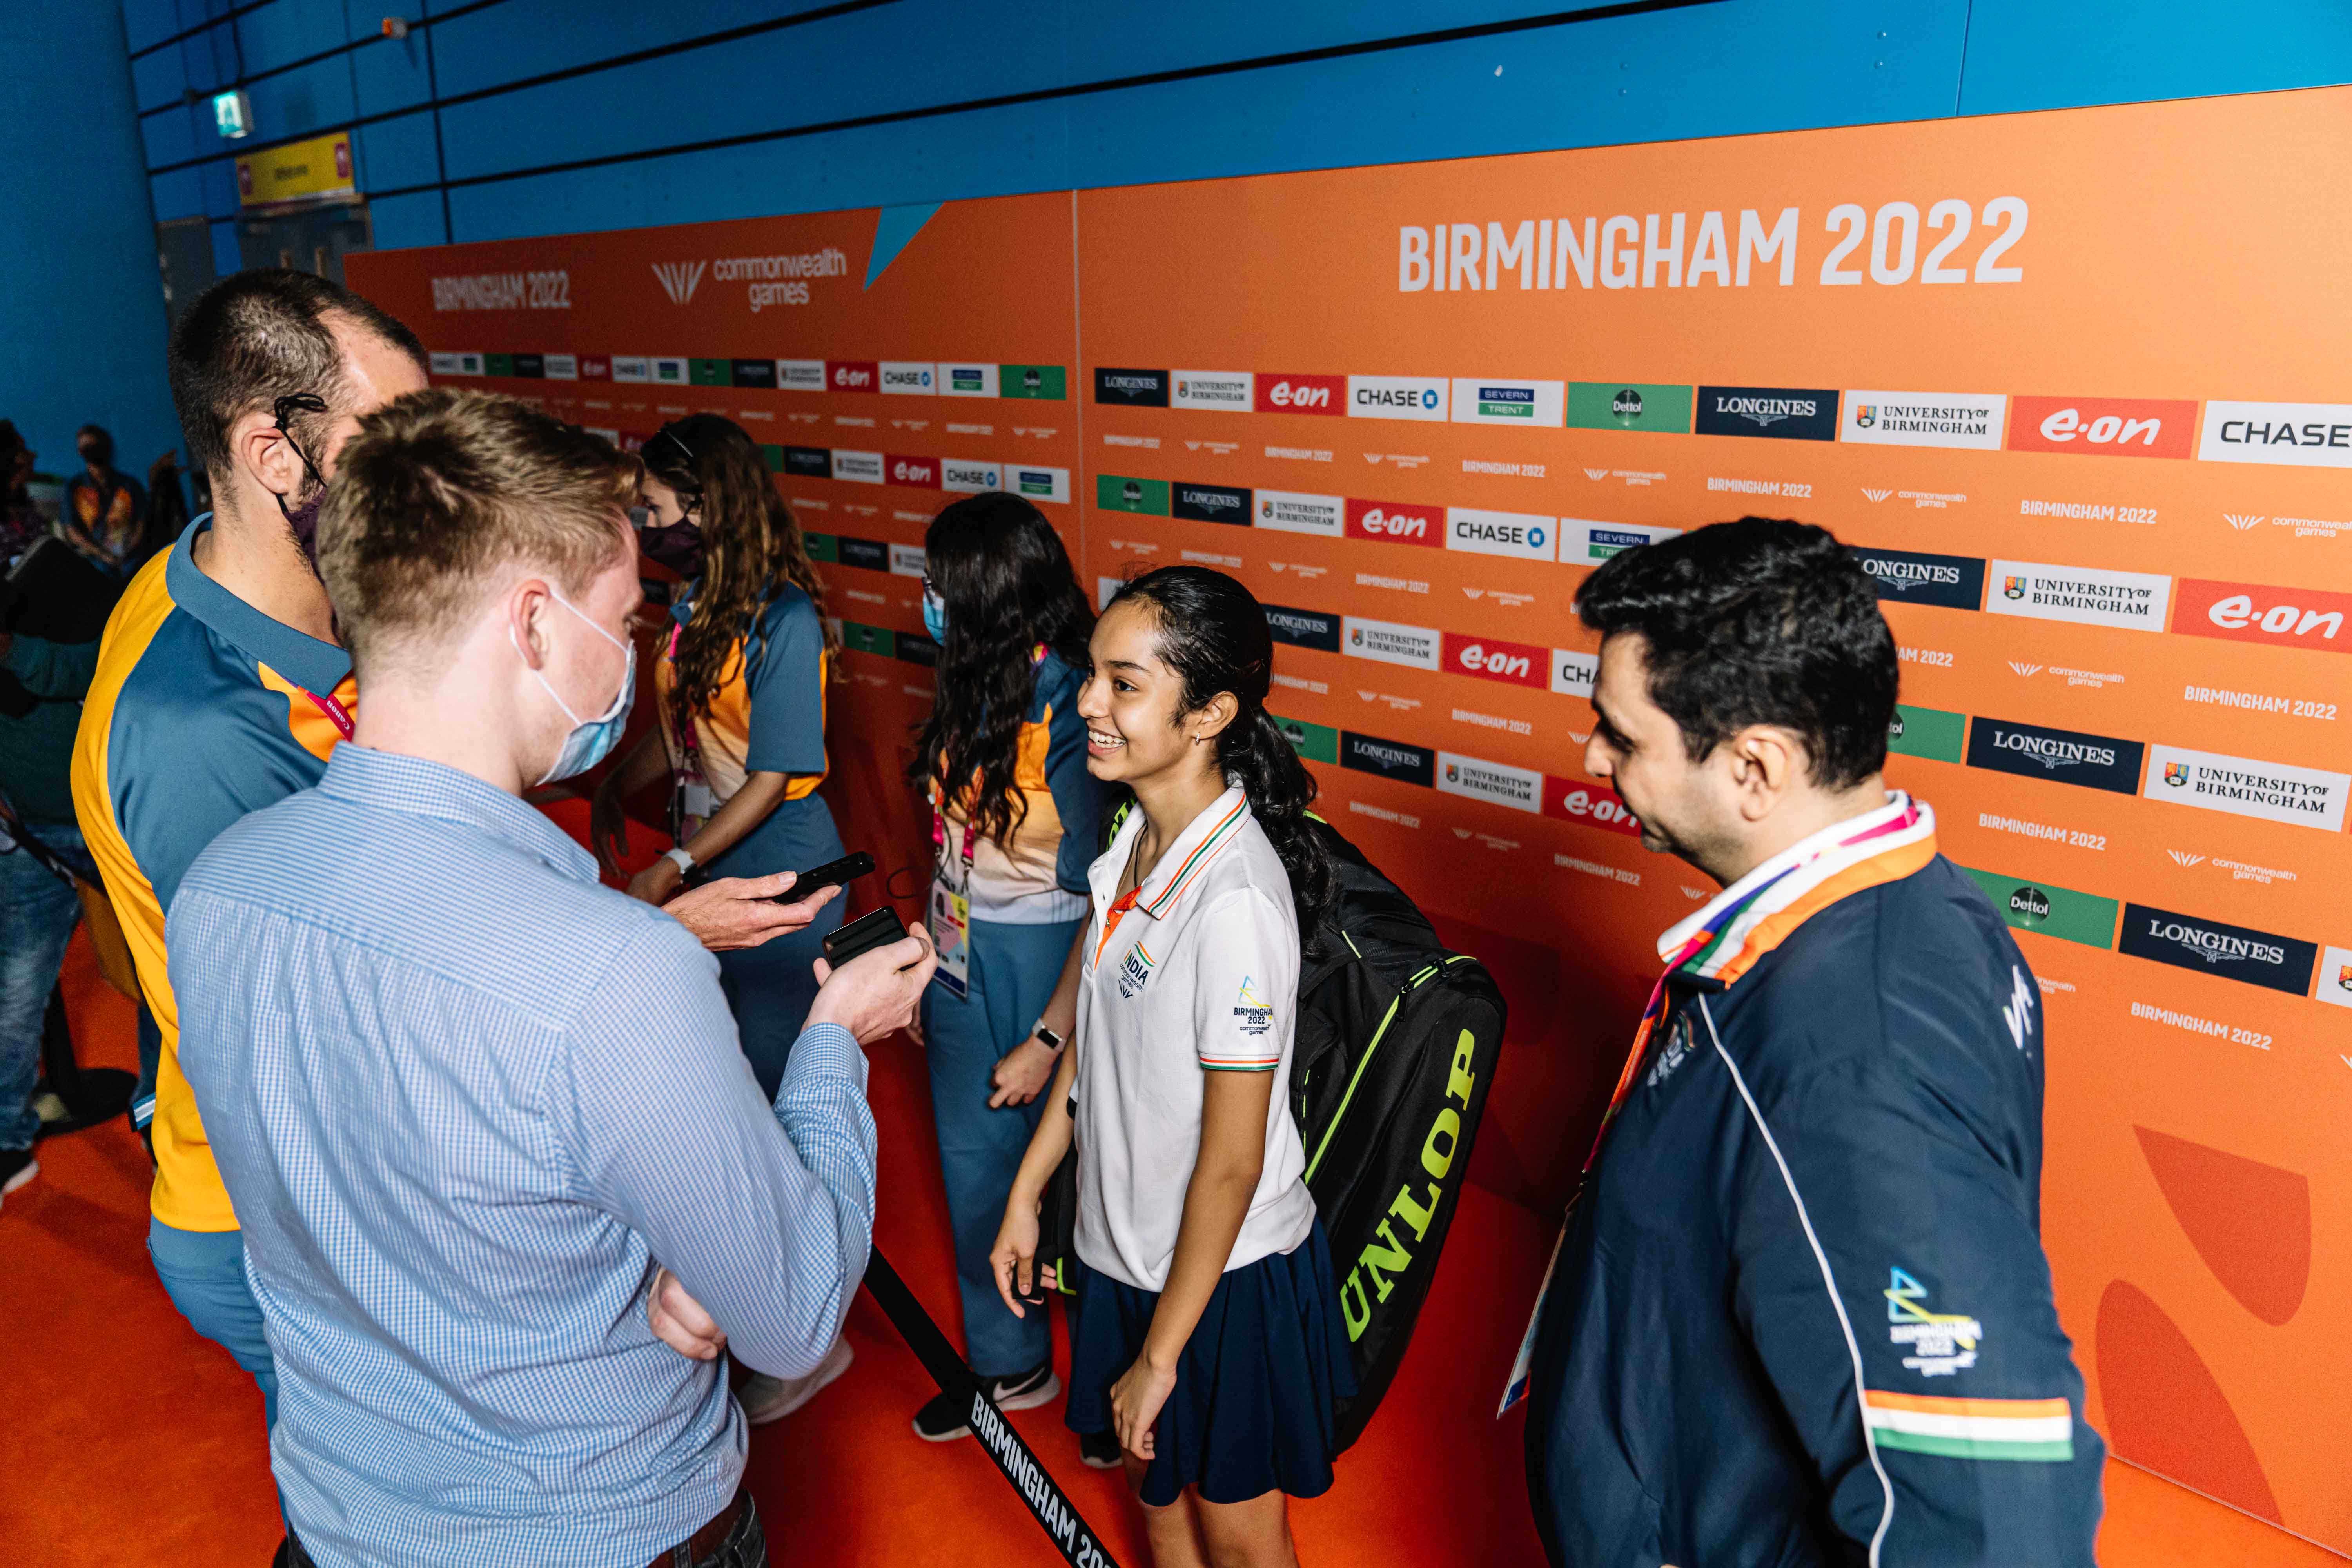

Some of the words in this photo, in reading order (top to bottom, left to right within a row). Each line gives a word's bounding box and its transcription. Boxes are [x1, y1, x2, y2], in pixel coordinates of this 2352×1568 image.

[1398, 207, 1800, 292] BIRMINGHAM
[1819, 196, 2029, 286] 2022
[713, 248, 846, 281] commonwealth
[432, 274, 526, 311] BIRMINGHAM
[528, 270, 571, 309] 2022
[748, 282, 809, 313] games
[884, 370, 919, 385] CHASE
[1104, 375, 1158, 390] LONGINES
[1191, 391, 1245, 402] BIRMINGHAM
[1357, 389, 1417, 407] CHASE
[1485, 390, 1528, 400] SEVERN
[1488, 405, 1524, 415] TRENT
[1613, 401, 1642, 413] Dettol
[1717, 396, 1816, 417] LONGINES
[1882, 419, 1987, 435] BIRMINGHAM
[2221, 421, 2352, 448] CHASE
[947, 468, 984, 485] CHASE
[1462, 460, 1519, 476] BIRMINGHAM
[1521, 464, 1545, 477] 2022
[1708, 477, 1779, 496] BIRMINGHAM
[1782, 483, 1812, 498] 2022
[1898, 490, 1966, 503] commonwealth
[1183, 492, 1240, 508] LONGINES
[1916, 499, 1947, 508] games
[1276, 512, 1334, 526] BIRMINGHAM
[2020, 500, 2114, 521] BIRMINGHAM
[2117, 507, 2157, 524] 2022
[1457, 522, 1523, 544] CHASE
[2272, 517, 2352, 530] commonweal
[2295, 527, 2336, 537] games
[1596, 532, 1643, 544] SEVERN
[1862, 558, 1960, 584] ONGINES
[1355, 573, 1406, 592] BIRMINGHAM
[1408, 580, 1430, 594] 2022
[2033, 592, 2149, 616] BIRMINGHAM
[1267, 612, 1327, 633] LONGINES
[1367, 641, 1430, 659] BIRMINGHAM
[1920, 650, 1953, 667] 2022
[2049, 666, 2124, 684] commonwealth
[2068, 677, 2102, 688] games
[2184, 685, 2290, 714] BIRMINGHAM
[2293, 701, 2337, 720] 2022
[1452, 708, 1508, 731] BIRMINGHAM
[1509, 719, 1532, 736] 2022
[1354, 740, 1421, 767] LONGINES
[1993, 731, 2115, 766] LONGINES
[1463, 778, 1531, 801] BIRMINGHAM
[2196, 781, 2326, 813] BIRMINGHAM
[1979, 813, 2066, 843] BIRMINGHAM
[2069, 830, 2106, 851] 2022
[1555, 853, 1614, 879] BIRMINGHAM
[1616, 869, 1641, 887] 2022
[2212, 857, 2296, 881] commonwealth
[2233, 869, 2271, 884] games
[2010, 896, 2049, 915] Dettol
[2149, 919, 2284, 965] LONGINES
[1120, 963, 1143, 992] commonwealth
[1123, 949, 1149, 985] INDIA
[1121, 974, 1134, 989] games
[2131, 1002, 2229, 1040] BIRMINGHAM
[2231, 1027, 2272, 1051] 2022
[1340, 1028, 1475, 1343] UNLOP
[971, 1391, 1077, 1553] BIRMINGHAM
